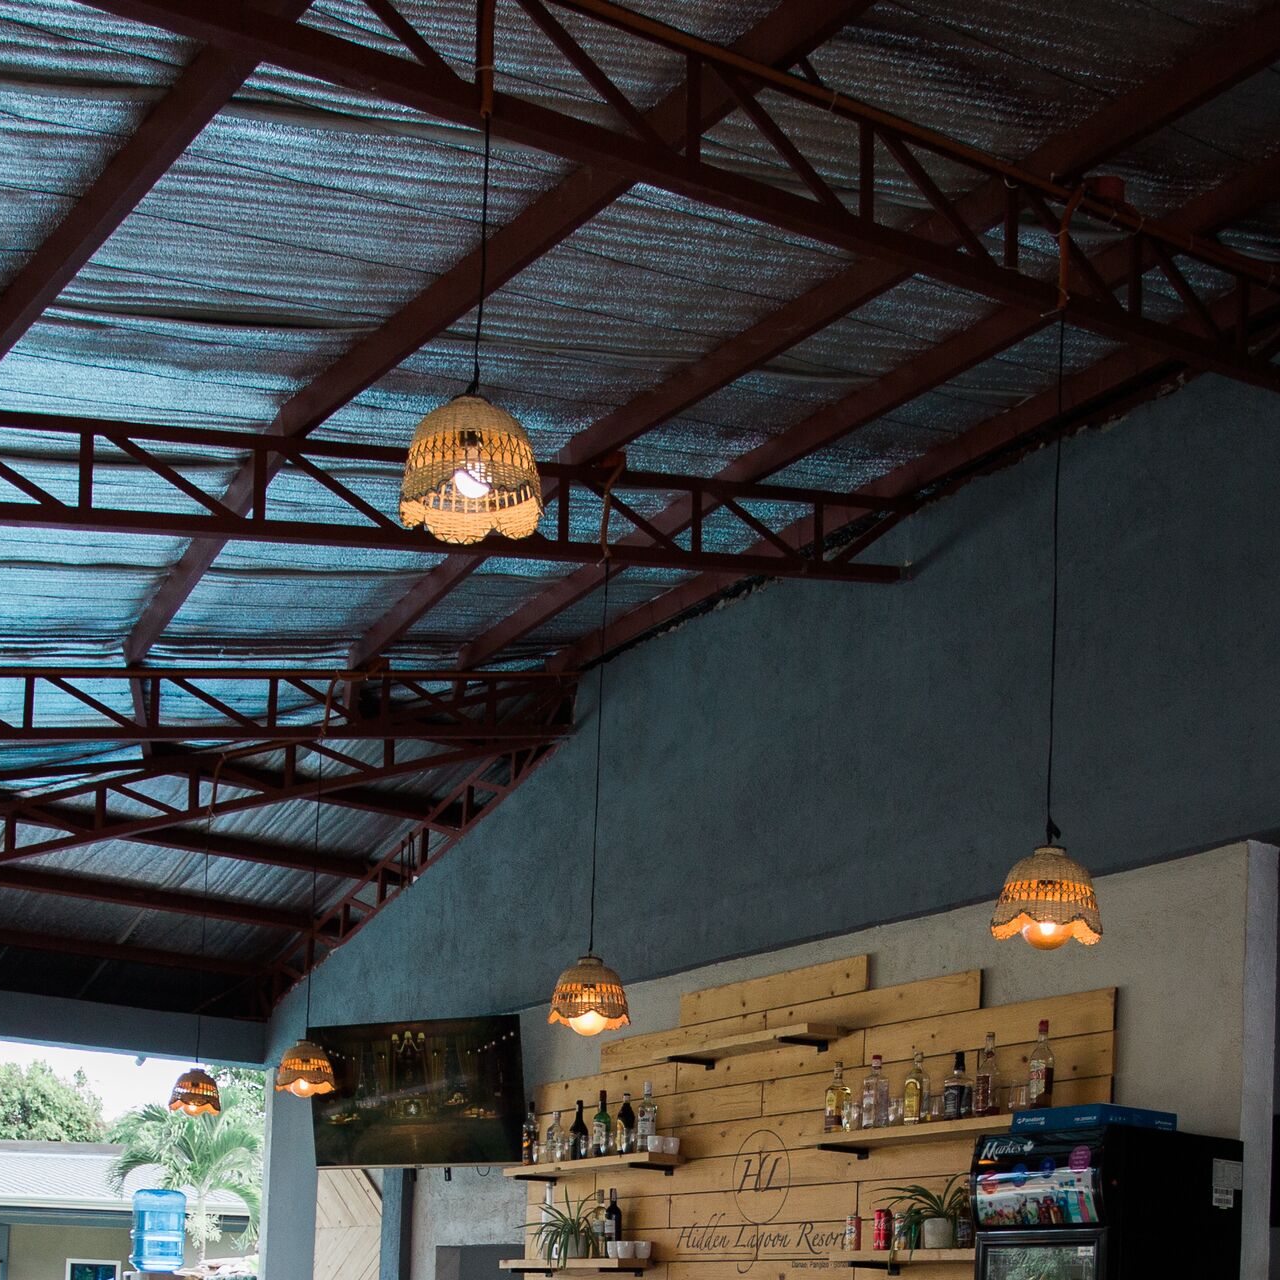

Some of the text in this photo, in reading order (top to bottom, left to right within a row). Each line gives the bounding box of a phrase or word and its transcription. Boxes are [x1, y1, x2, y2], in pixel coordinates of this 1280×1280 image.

[737, 1153, 782, 1194] HL
[676, 1212, 730, 1251] Hidden
[733, 1223, 792, 1274] Lagoon
[796, 1222, 847, 1254] Resort
